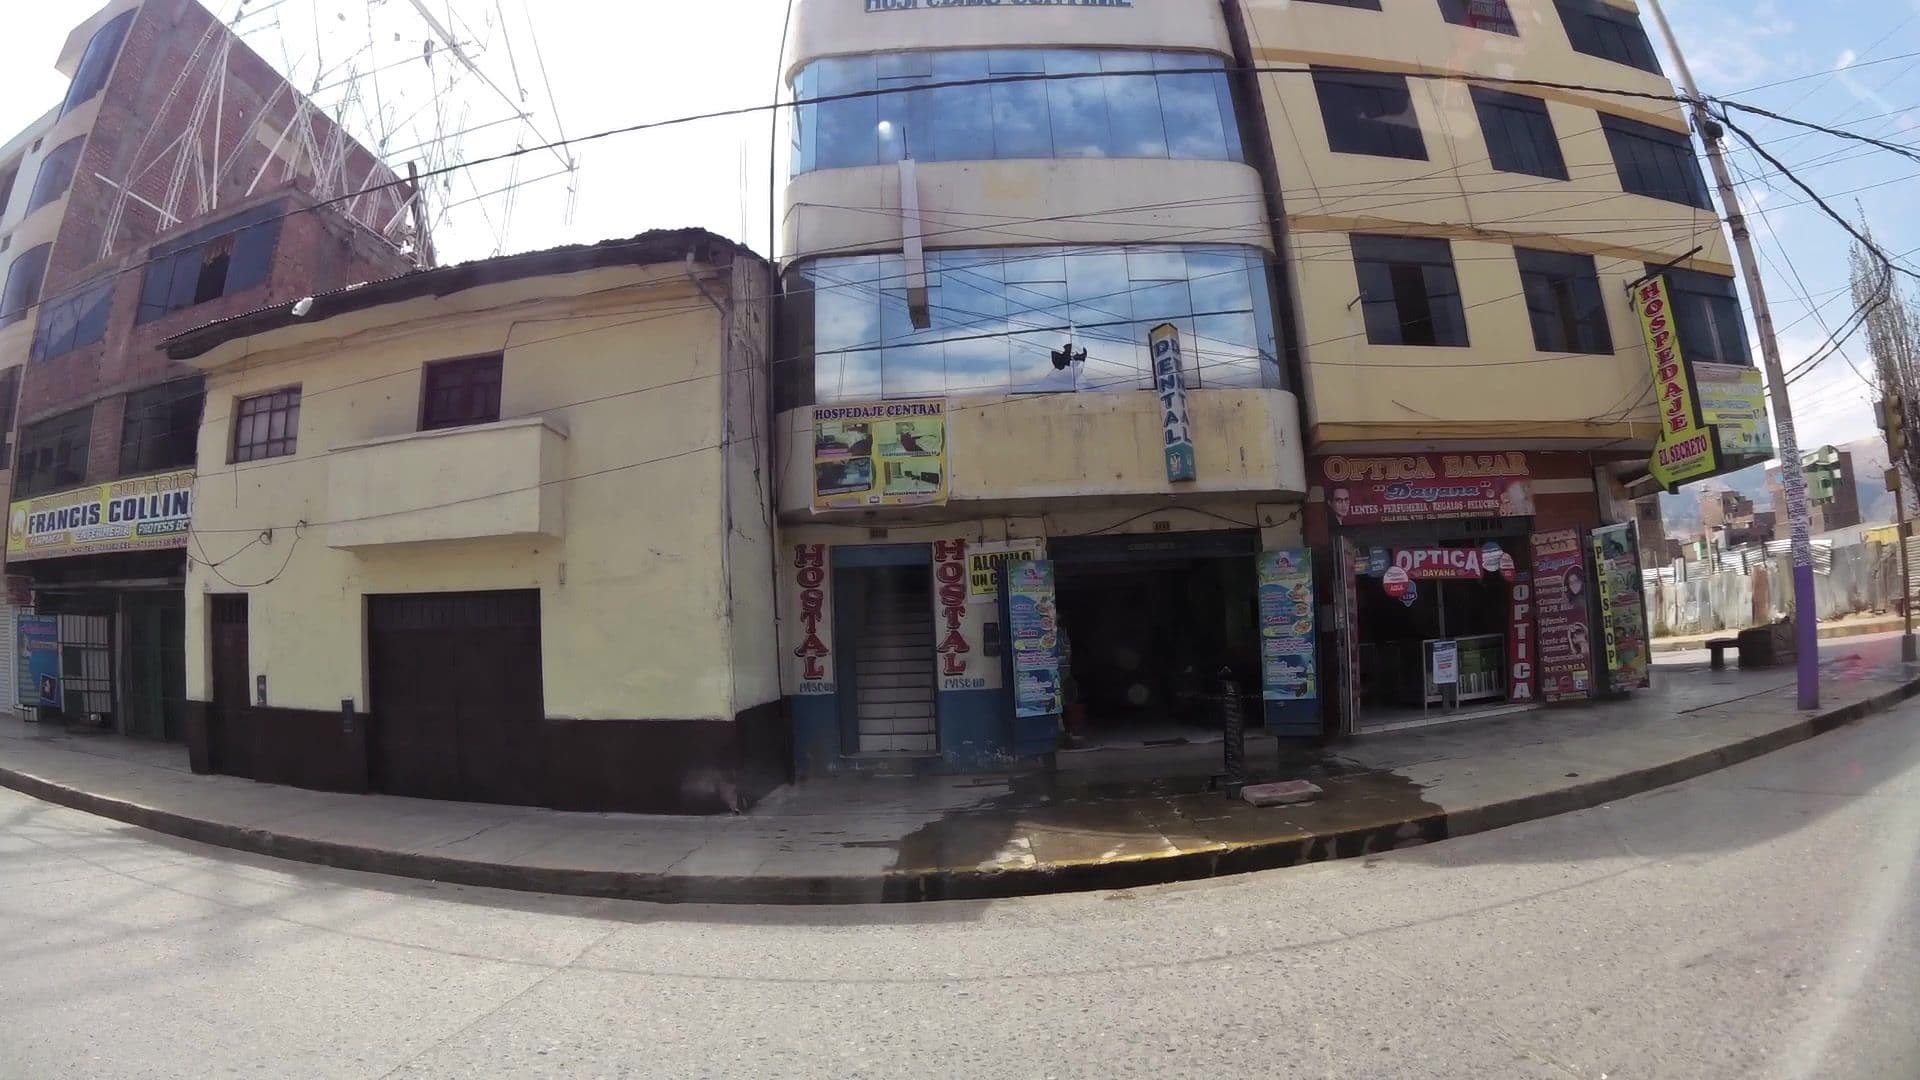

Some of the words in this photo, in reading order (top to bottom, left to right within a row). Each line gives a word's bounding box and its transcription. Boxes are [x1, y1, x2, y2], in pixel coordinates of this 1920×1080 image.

[1640, 281, 1687, 434] HOSPEDAJE
[1154, 340, 1181, 445] DENTAL
[815, 406, 884, 420] HOSPEDAJE
[887, 403, 942, 416] CENTRAL
[1323, 456, 1436, 481] OPTICA
[1442, 452, 1530, 478] BAZAR
[1658, 448, 1669, 467] EL
[1670, 436, 1708, 463] SECRETO
[28, 503, 101, 535] FRANCIS
[1350, 504, 1378, 516] LENTES
[1383, 502, 1429, 514] PERFUMERIA
[1432, 501, 1464, 511] REGALOS
[1396, 550, 1481, 577] OPTICA
[1422, 569, 1456, 577] DAYANA
[973, 573, 987, 586] UN
[793, 543, 830, 680] HOSTAL
[934, 538, 971, 677] HOSTAL
[1512, 584, 1531, 699] OPTICA
